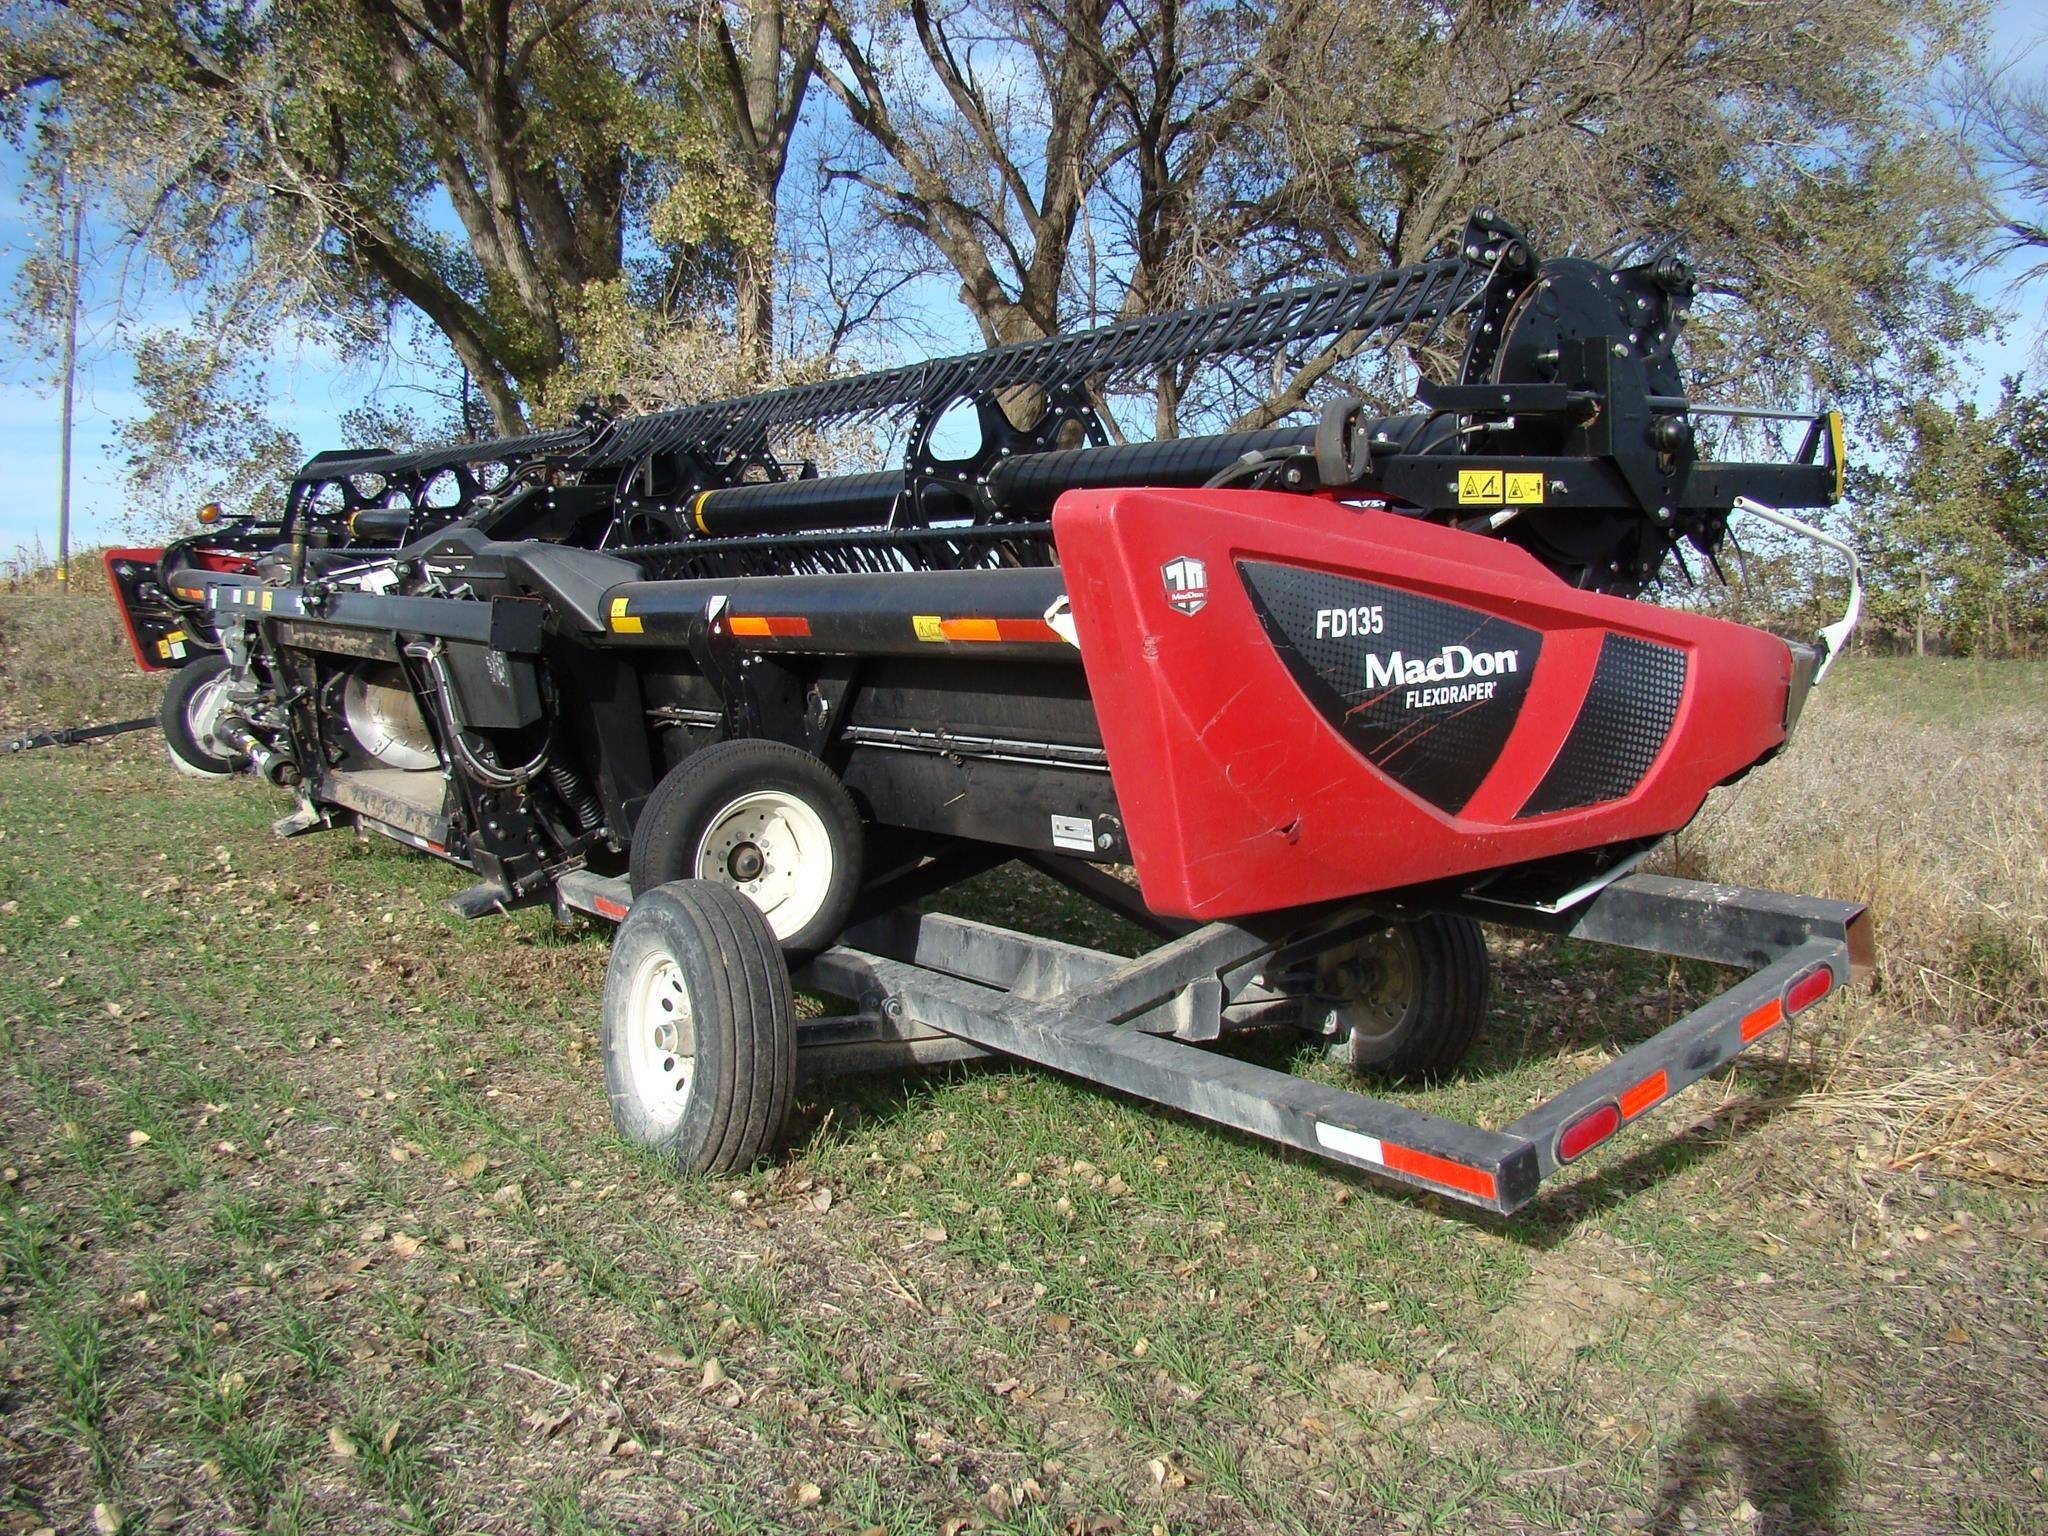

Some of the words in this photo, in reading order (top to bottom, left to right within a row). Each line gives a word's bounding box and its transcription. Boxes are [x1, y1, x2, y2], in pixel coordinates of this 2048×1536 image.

[1315, 606, 1384, 640] FD135
[1364, 645, 1518, 689] MacDon
[1405, 682, 1497, 710] FLEXDRAPER
